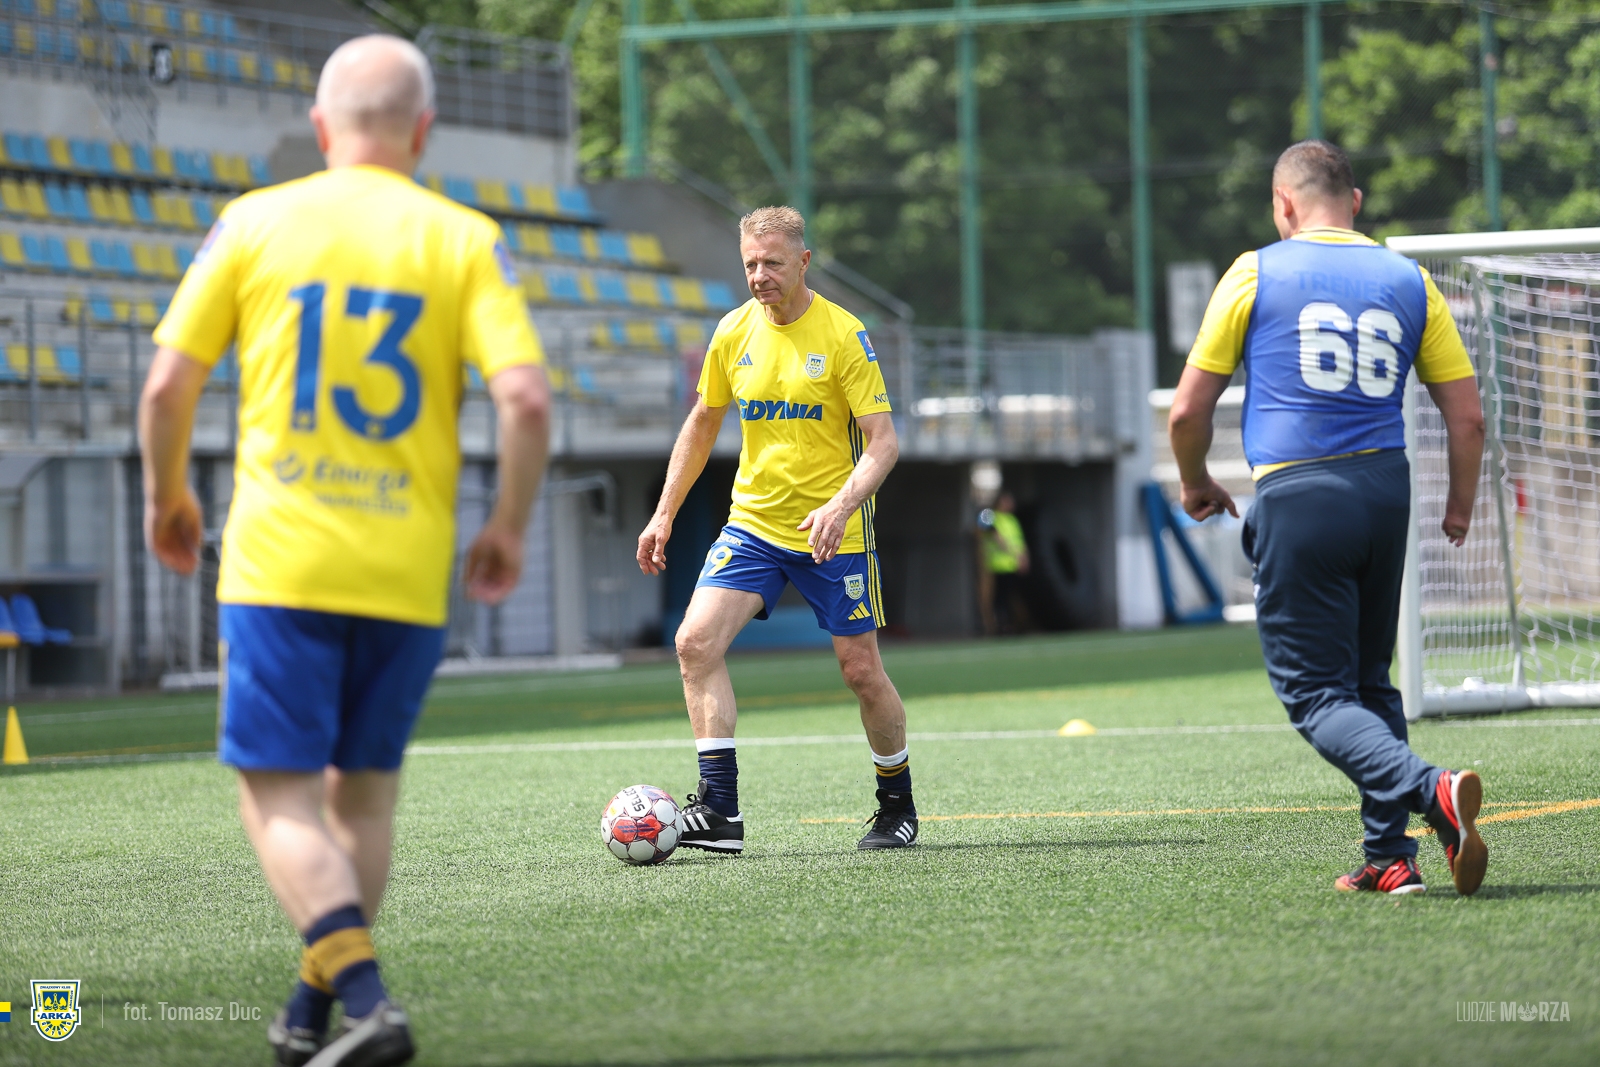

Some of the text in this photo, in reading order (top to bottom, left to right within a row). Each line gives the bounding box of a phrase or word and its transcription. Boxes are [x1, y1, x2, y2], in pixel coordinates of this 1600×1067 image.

[288, 281, 424, 442] 13
[1298, 302, 1403, 398] 66
[700, 545, 733, 578] 9
[622, 788, 646, 812] SELEC
